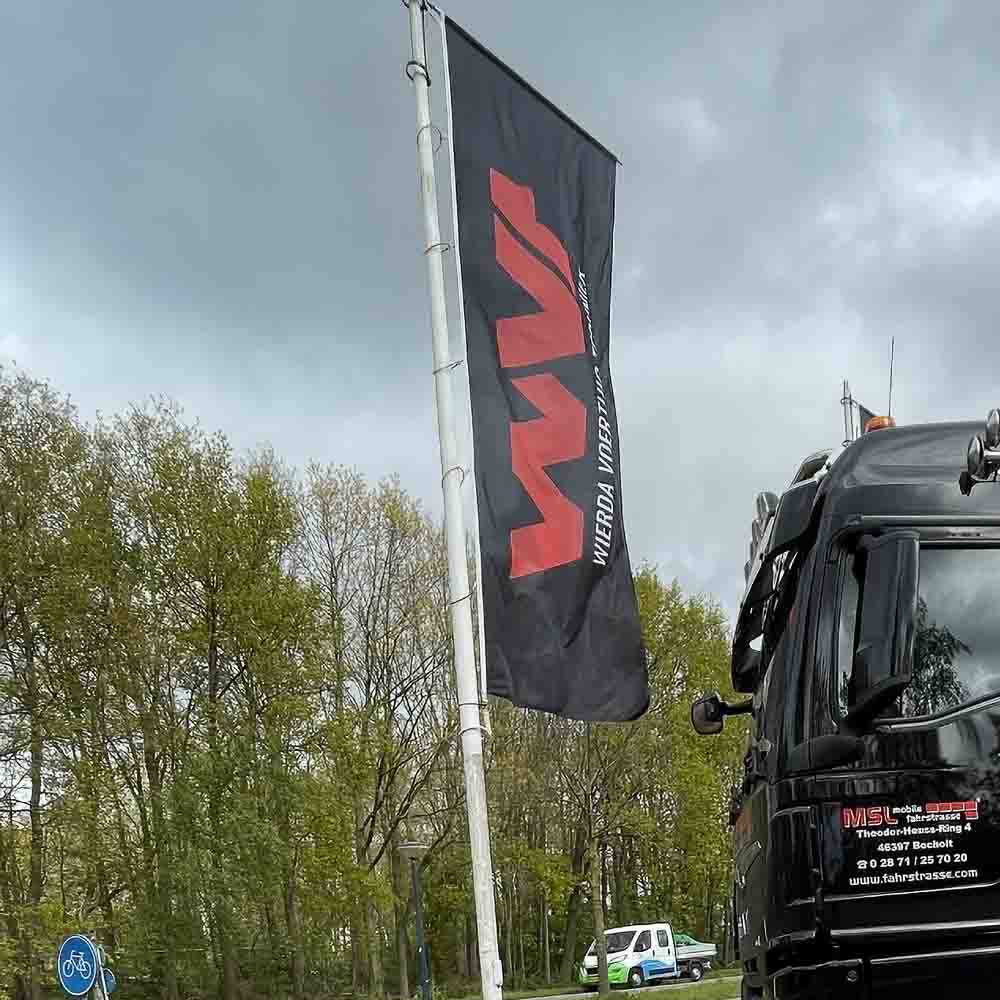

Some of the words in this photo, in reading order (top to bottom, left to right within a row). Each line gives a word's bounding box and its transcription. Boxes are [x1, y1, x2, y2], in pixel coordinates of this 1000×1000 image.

[592, 482, 615, 566] WIERDA
[843, 806, 899, 828] MSL
[892, 805, 922, 814] mobile
[906, 813, 961, 822] fahrstrasse
[964, 822, 972, 832] 4
[877, 842, 910, 852] 46397
[912, 840, 954, 850] Bocholt
[869, 859, 877, 868] 0
[880, 858, 895, 867] 28
[897, 857, 910, 866] 71
[920, 856, 934, 865] 25
[937, 854, 951, 863] 70
[953, 853, 968, 862] 20
[849, 869, 978, 886] www.fahrstrasse.com
